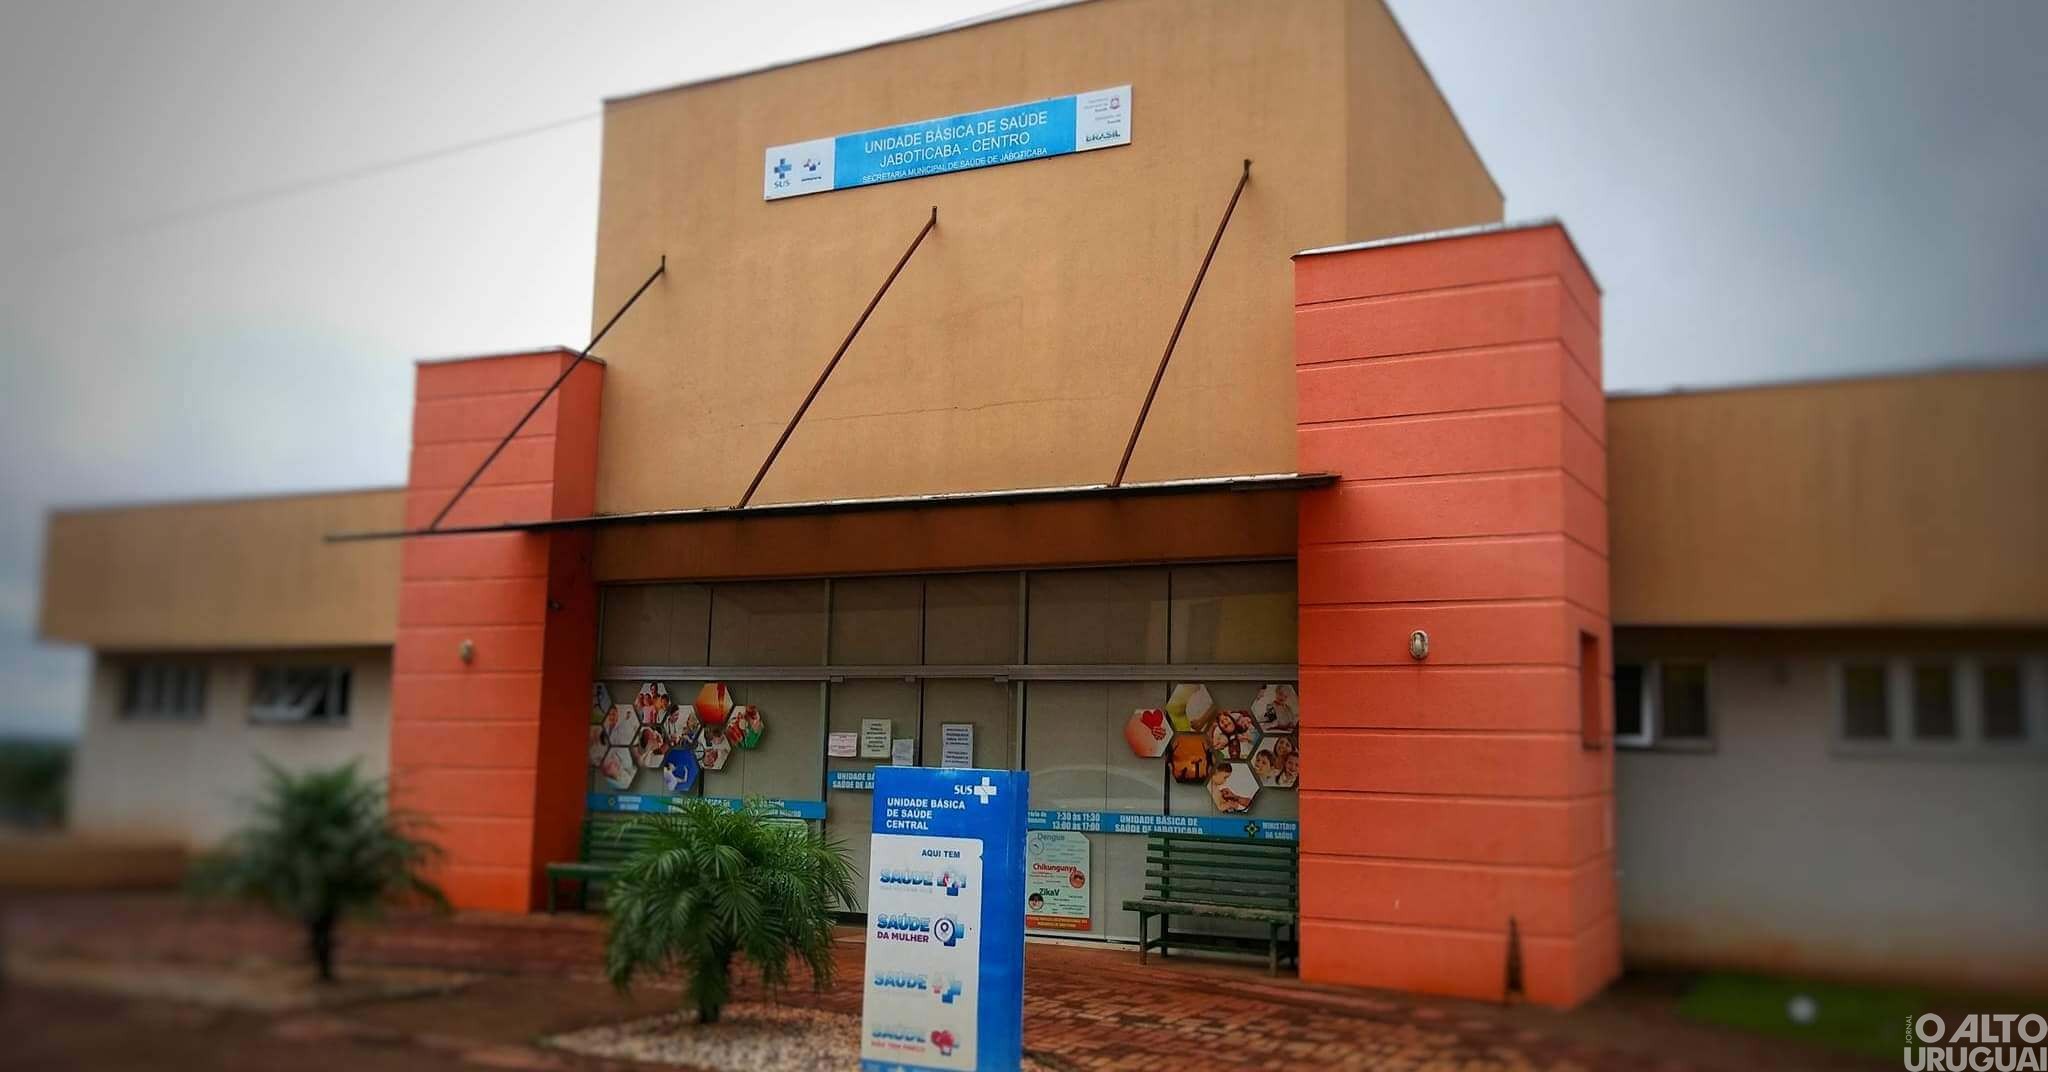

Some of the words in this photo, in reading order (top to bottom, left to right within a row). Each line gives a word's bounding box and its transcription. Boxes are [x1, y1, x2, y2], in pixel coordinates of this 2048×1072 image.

[865, 133, 922, 153] UNIDADE
[925, 122, 975, 143] BÁSICA
[977, 120, 996, 135] DE
[1000, 110, 1048, 131] SAÚDE
[880, 143, 962, 168] JABOTICABA
[972, 131, 1030, 152] CENTRO
[863, 170, 907, 183] SECRETARIA
[908, 164, 945, 177] MUNICIPAL
[987, 155, 999, 163] DE
[1000, 146, 1048, 161] JABOTICABA
[774, 180, 791, 188] SUS
[954, 785, 973, 795] SUS
[887, 798, 928, 808] UNIDADE
[931, 798, 965, 810] BÁSICA
[887, 809, 899, 817] DE
[901, 808, 933, 819] SAÚDE
[1083, 812, 1100, 822] 11:30
[886, 820, 928, 830] CENTRAL
[1120, 814, 1154, 824] UNIDADE
[1155, 815, 1186, 826] BÁSICA
[1187, 817, 1198, 826] DE
[1082, 822, 1100, 831] 17:00
[1115, 823, 1141, 832] SAÚDE
[1142, 825, 1152, 833] DE
[1037, 832, 1066, 842] Dengue
[921, 849, 941, 858] AQUI
[944, 850, 961, 858] TEM
[1032, 863, 1077, 874] Chikungunya
[877, 912, 930, 932] SAÚDE
[877, 931, 890, 940] DA
[891, 933, 929, 943] MULHER
